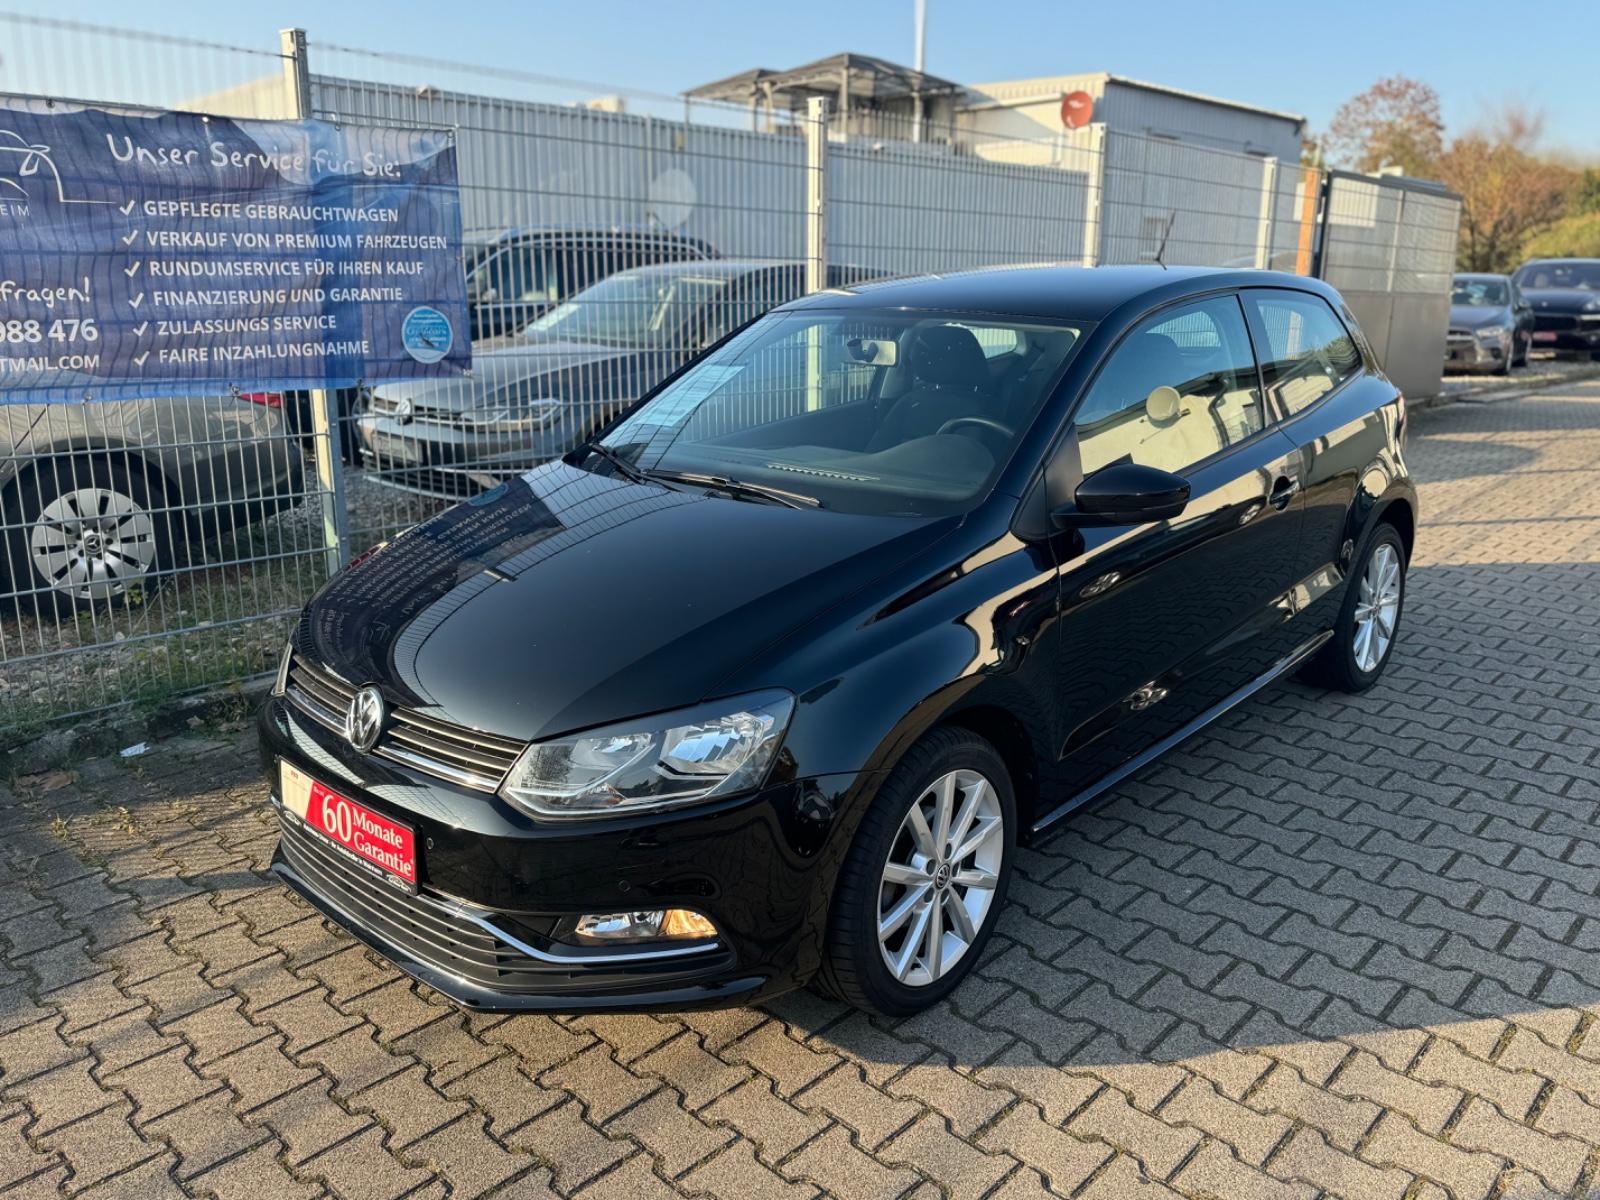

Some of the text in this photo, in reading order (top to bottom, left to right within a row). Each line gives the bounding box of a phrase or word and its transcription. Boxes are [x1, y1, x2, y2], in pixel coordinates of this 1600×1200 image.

[106, 133, 401, 178] Unser Service für Sie:
[144, 200, 398, 222] GEPFLEGTE GEBRAUCHTWAGEN
[147, 231, 447, 249] VERKAUF VON PREMIUM FAHRZEUGEN
[150, 258, 424, 276] RUNDUMSERVICE FÜR IHREN KAUF
[153, 288, 403, 306] FINANZIERUNG UND GARANTIE
[47, 318, 98, 342] 476
[157, 315, 336, 336] ZULASSUNGS SERVICE
[159, 341, 369, 363] FAIRE INZAHLUNGNAHME
[322, 795, 352, 843] 60
[352, 806, 404, 849] Monate
